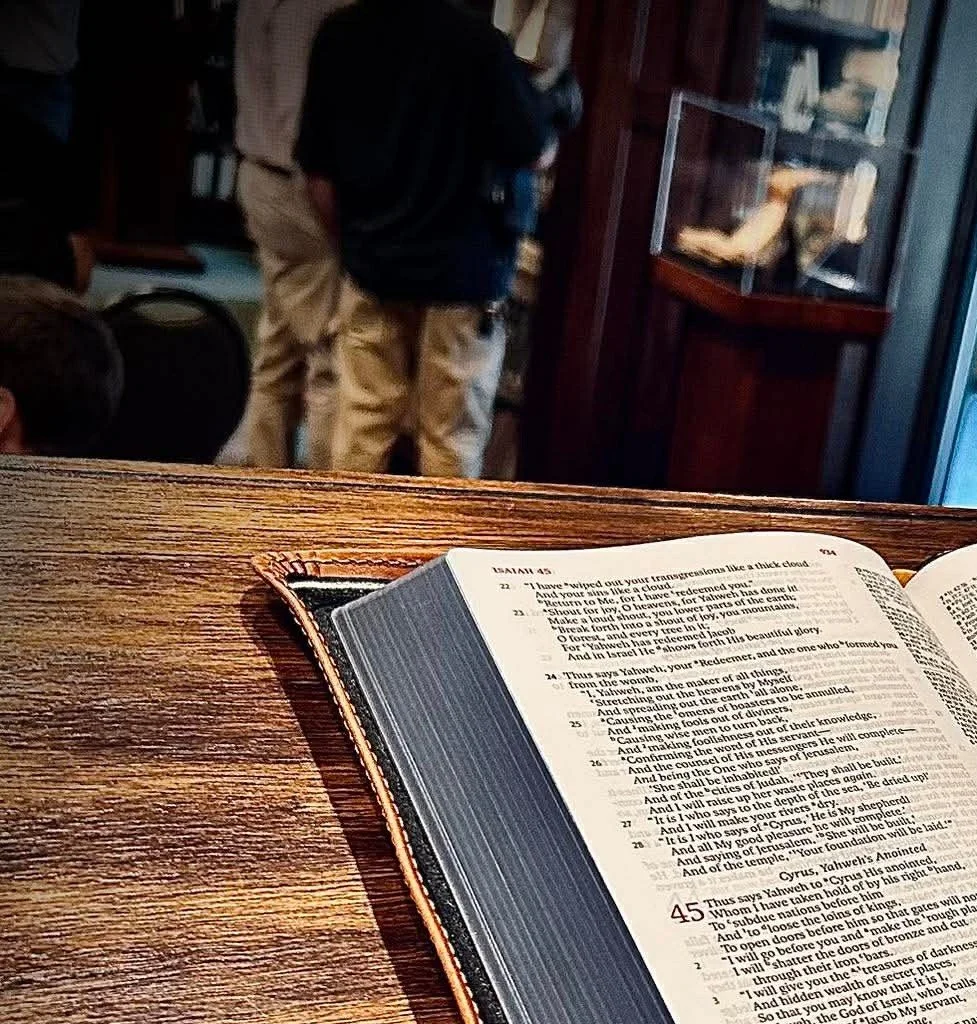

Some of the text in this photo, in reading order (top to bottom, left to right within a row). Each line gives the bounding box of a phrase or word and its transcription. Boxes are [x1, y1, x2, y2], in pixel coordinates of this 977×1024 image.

[535, 590, 559, 599] And
[559, 591, 584, 599] your
[584, 588, 609, 597] sins
[609, 585, 631, 595] like
[546, 616, 578, 625] Make
[588, 614, 615, 623] loud
[651, 609, 673, 619] you
[672, 605, 704, 615] lower
[705, 601, 733, 612] parts
[746, 597, 764, 605] the
[568, 681, 598, 689] from
[598, 678, 618, 687] the
[628, 763, 653, 775] And
[652, 762, 673, 772] the
[674, 755, 720, 769] counsel
[733, 750, 754, 761] His
[754, 740, 818, 757] messengers
[835, 732, 857, 743] will
[633, 773, 658, 785] And
[657, 771, 691, 782] being
[690, 768, 711, 777] the
[711, 765, 737, 774] One
[737, 760, 763, 770] who
[764, 756, 788, 768] says
[649, 803, 674, 815] And
[681, 799, 705, 810] will
[705, 797, 735, 807] raise
[750, 790, 772, 800] her
[772, 784, 806, 795] waste
[806, 777, 841, 792] places
[621, 820, 631, 828] 27
[671, 844, 697, 856] And
[697, 841, 713, 852] all
[734, 833, 765, 848] good
[764, 826, 813, 843] pleasure
[829, 816, 852, 828] will
[819, 854, 874, 873] Yahweh's
[875, 842, 928, 862] Anointed
[708, 906, 752, 919] Whom
[758, 899, 789, 911] have
[789, 892, 824, 905] taken
[822, 884, 852, 898] hold
[880, 874, 900, 885] his
[900, 869, 929, 882] right
[670, 901, 705, 924] 45
[739, 939, 771, 951] open
[771, 931, 806, 944] doors
[804, 923, 845, 937] before
[843, 918, 870, 929] him
[884, 908, 910, 920] that
[910, 901, 940, 916] gates
[939, 895, 962, 907] will
[753, 997, 779, 1012] And
[777, 990, 824, 1006] hidden
[823, 979, 866, 996] wealth
[880, 968, 917, 983] secret
